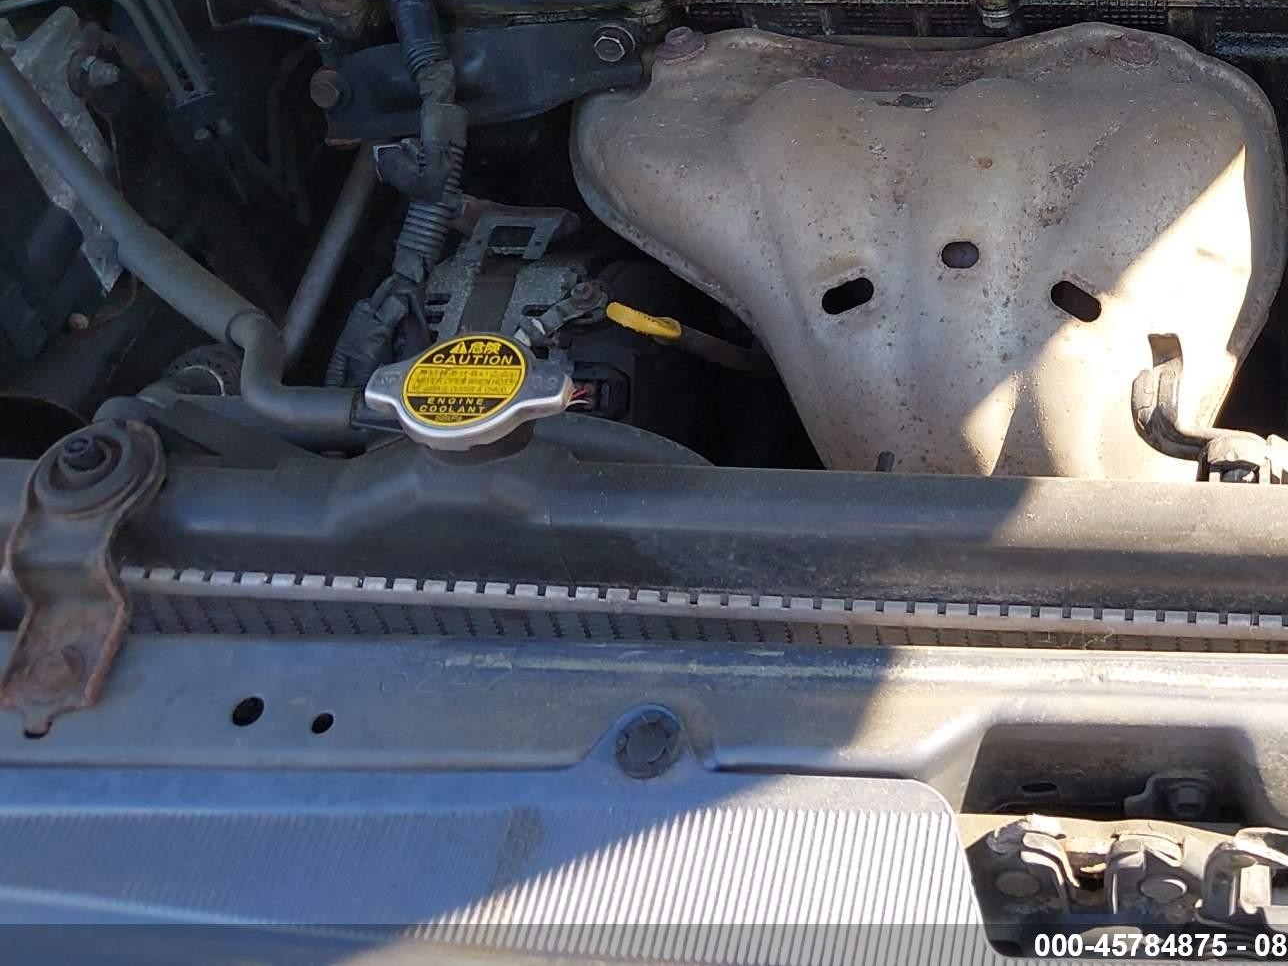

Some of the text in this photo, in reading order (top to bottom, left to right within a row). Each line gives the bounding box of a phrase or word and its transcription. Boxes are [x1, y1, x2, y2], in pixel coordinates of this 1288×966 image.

[432, 353, 514, 365] CAUTION
[427, 397, 485, 405] ENGINE
[419, 405, 486, 413] COOLANT
